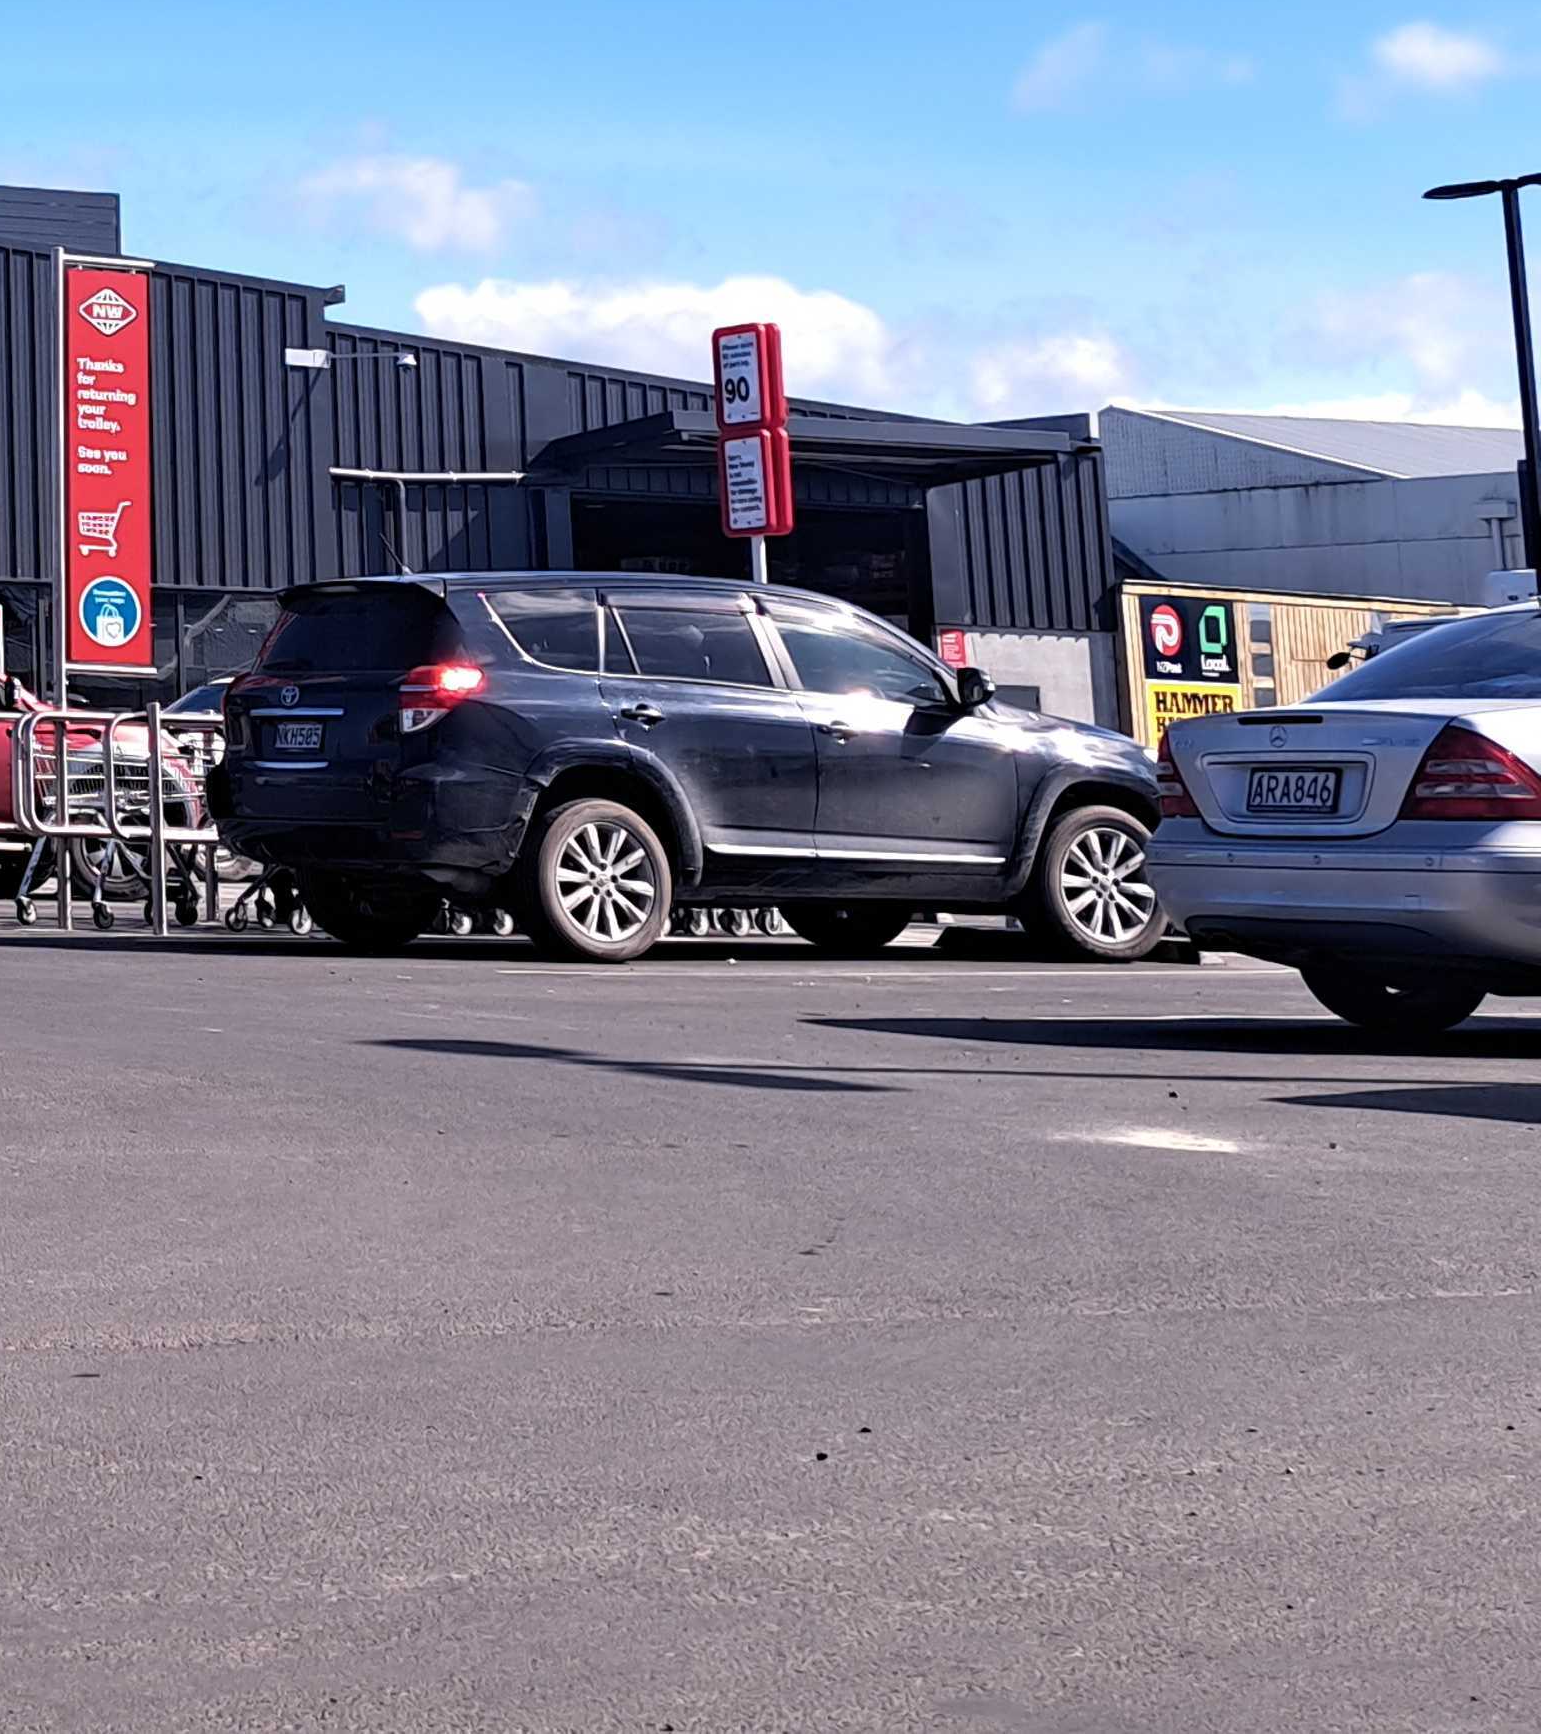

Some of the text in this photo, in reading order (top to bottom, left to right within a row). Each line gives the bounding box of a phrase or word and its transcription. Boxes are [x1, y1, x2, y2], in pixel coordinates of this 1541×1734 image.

[91, 303, 124, 319] NW
[77, 357, 124, 373] Thanks
[77, 372, 95, 385] for
[77, 389, 136, 405] returning
[724, 376, 750, 404] 90
[77, 404, 106, 416] your
[78, 446, 127, 462] See you
[77, 463, 112, 474] soon.
[1153, 691, 1234, 715] HAMMER
[1251, 772, 1332, 806] ARA846
